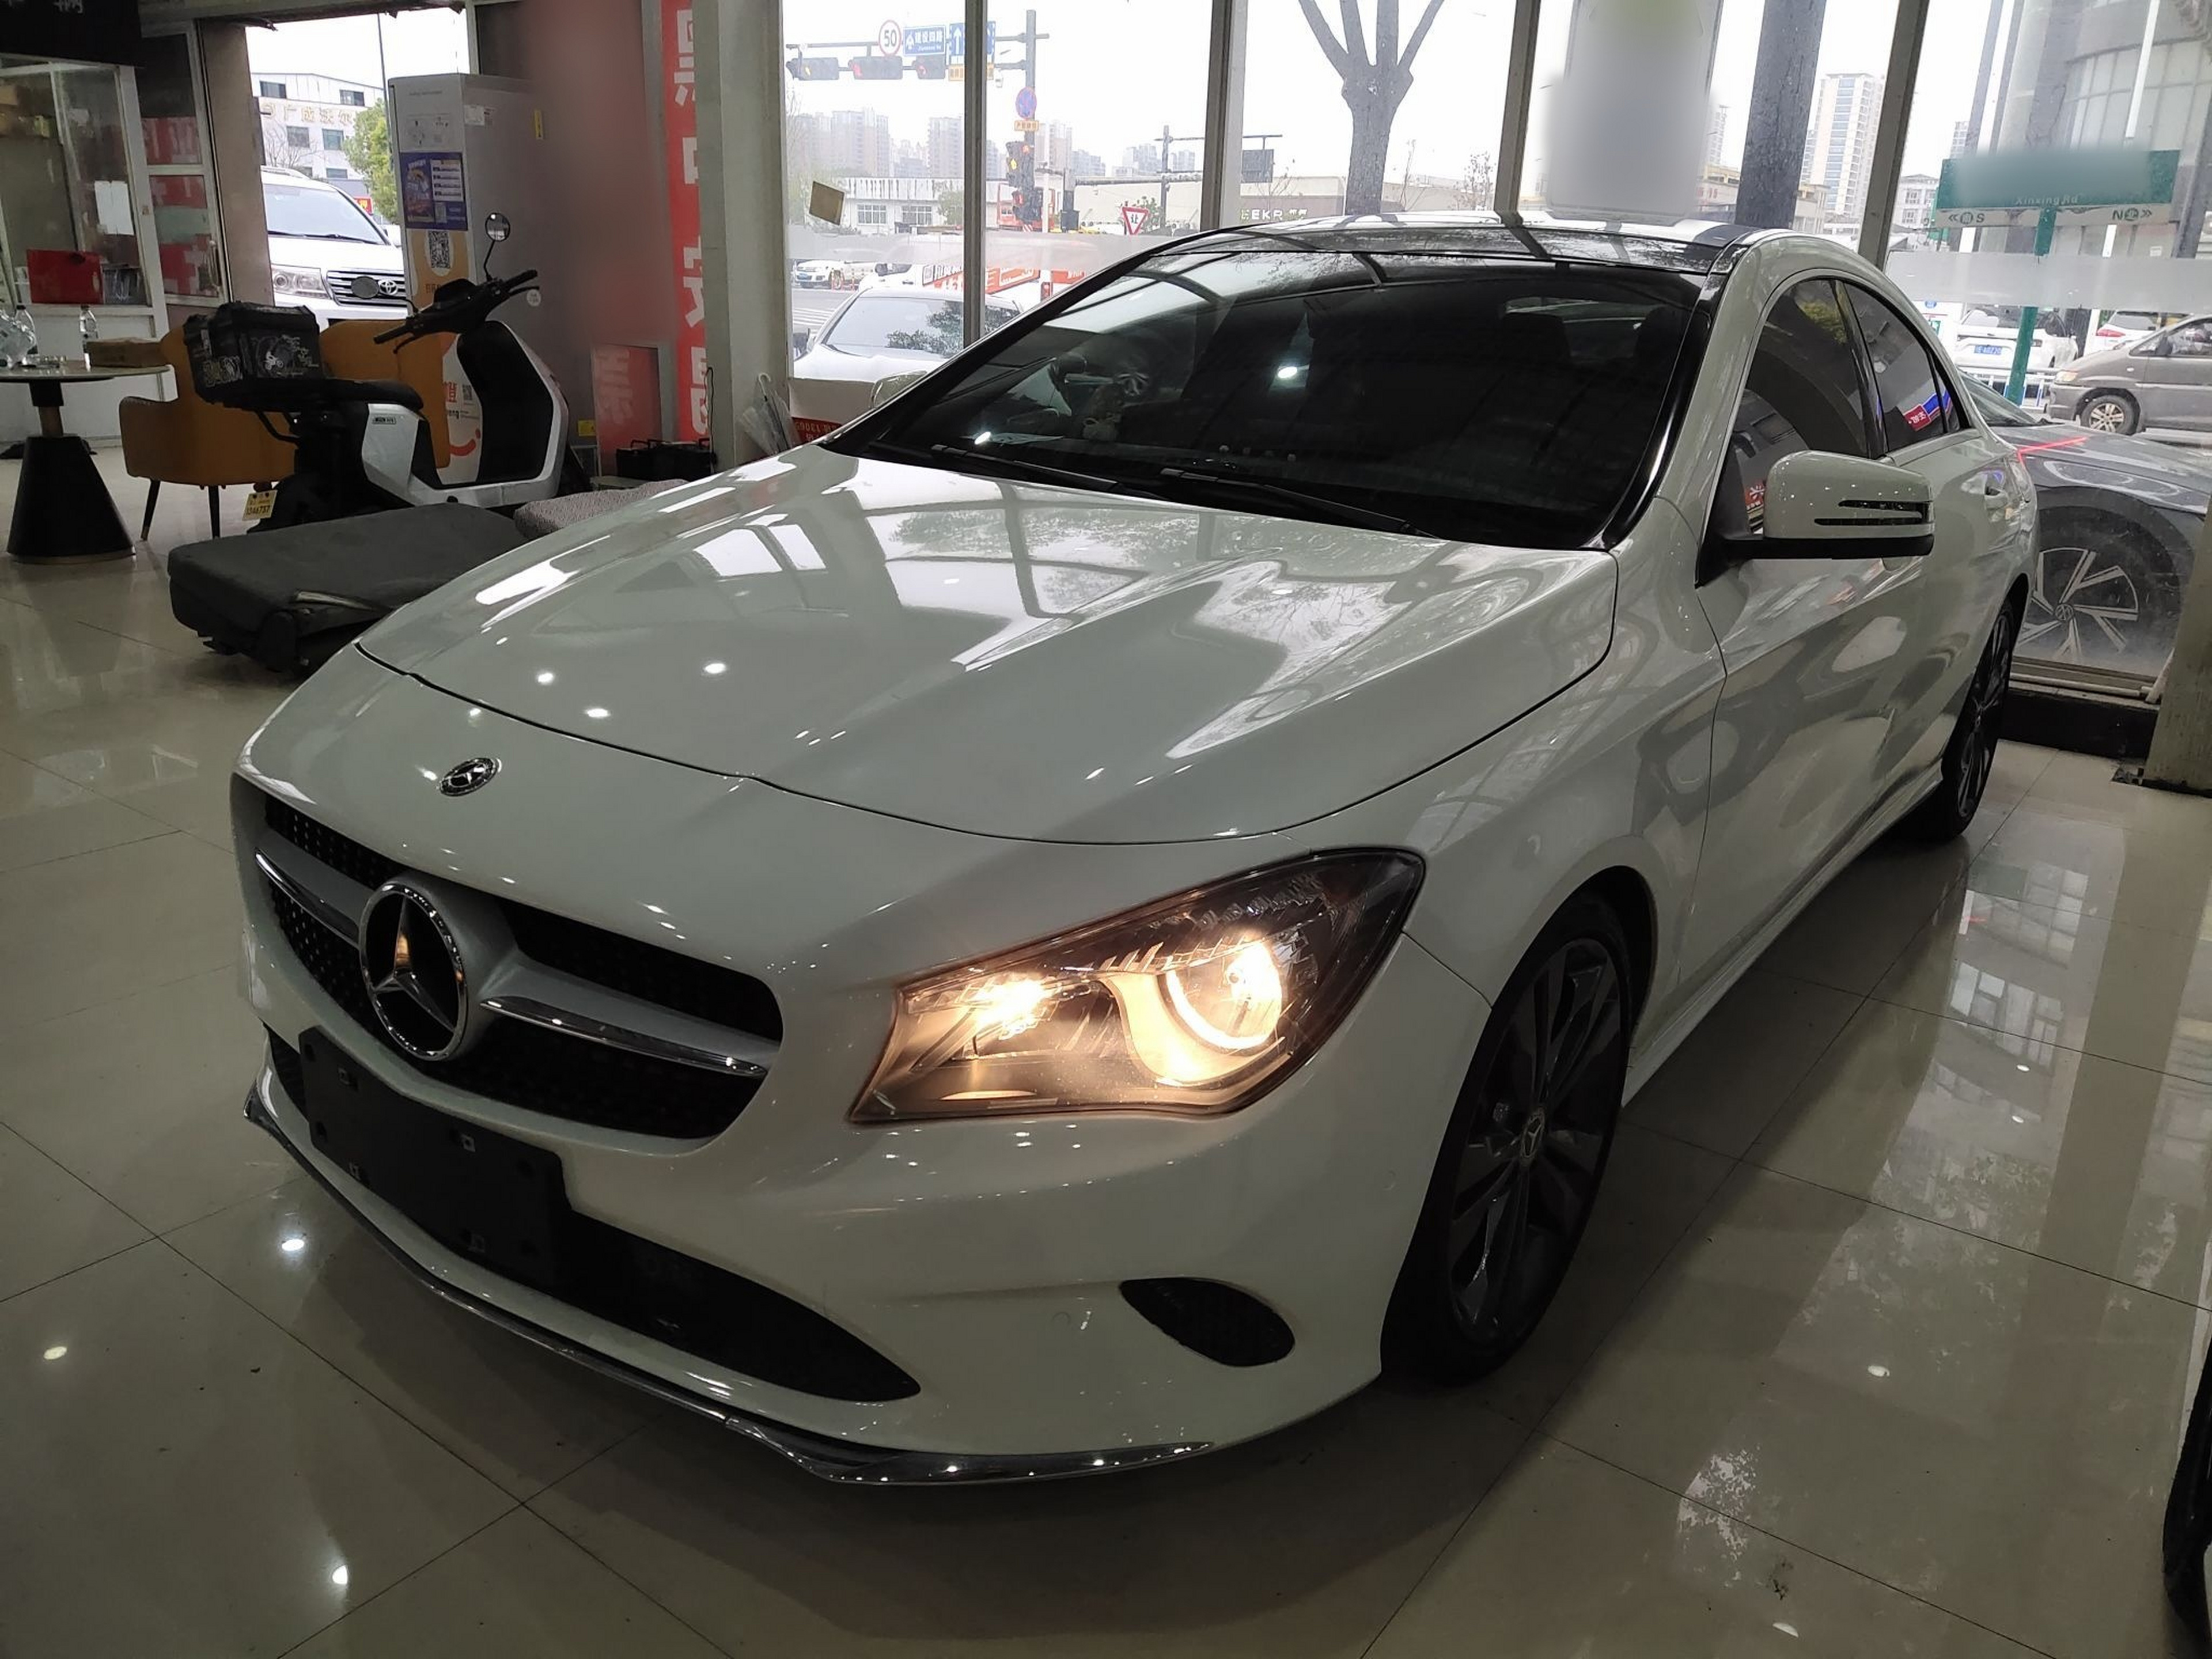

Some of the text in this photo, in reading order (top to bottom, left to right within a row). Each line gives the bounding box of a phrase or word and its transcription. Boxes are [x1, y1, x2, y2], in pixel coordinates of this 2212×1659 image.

[884, 30, 897, 47] 50
[2016, 195, 2078, 206] Xinxing Rd
[1976, 213, 1985, 223] S
[2112, 210, 2123, 219] N
